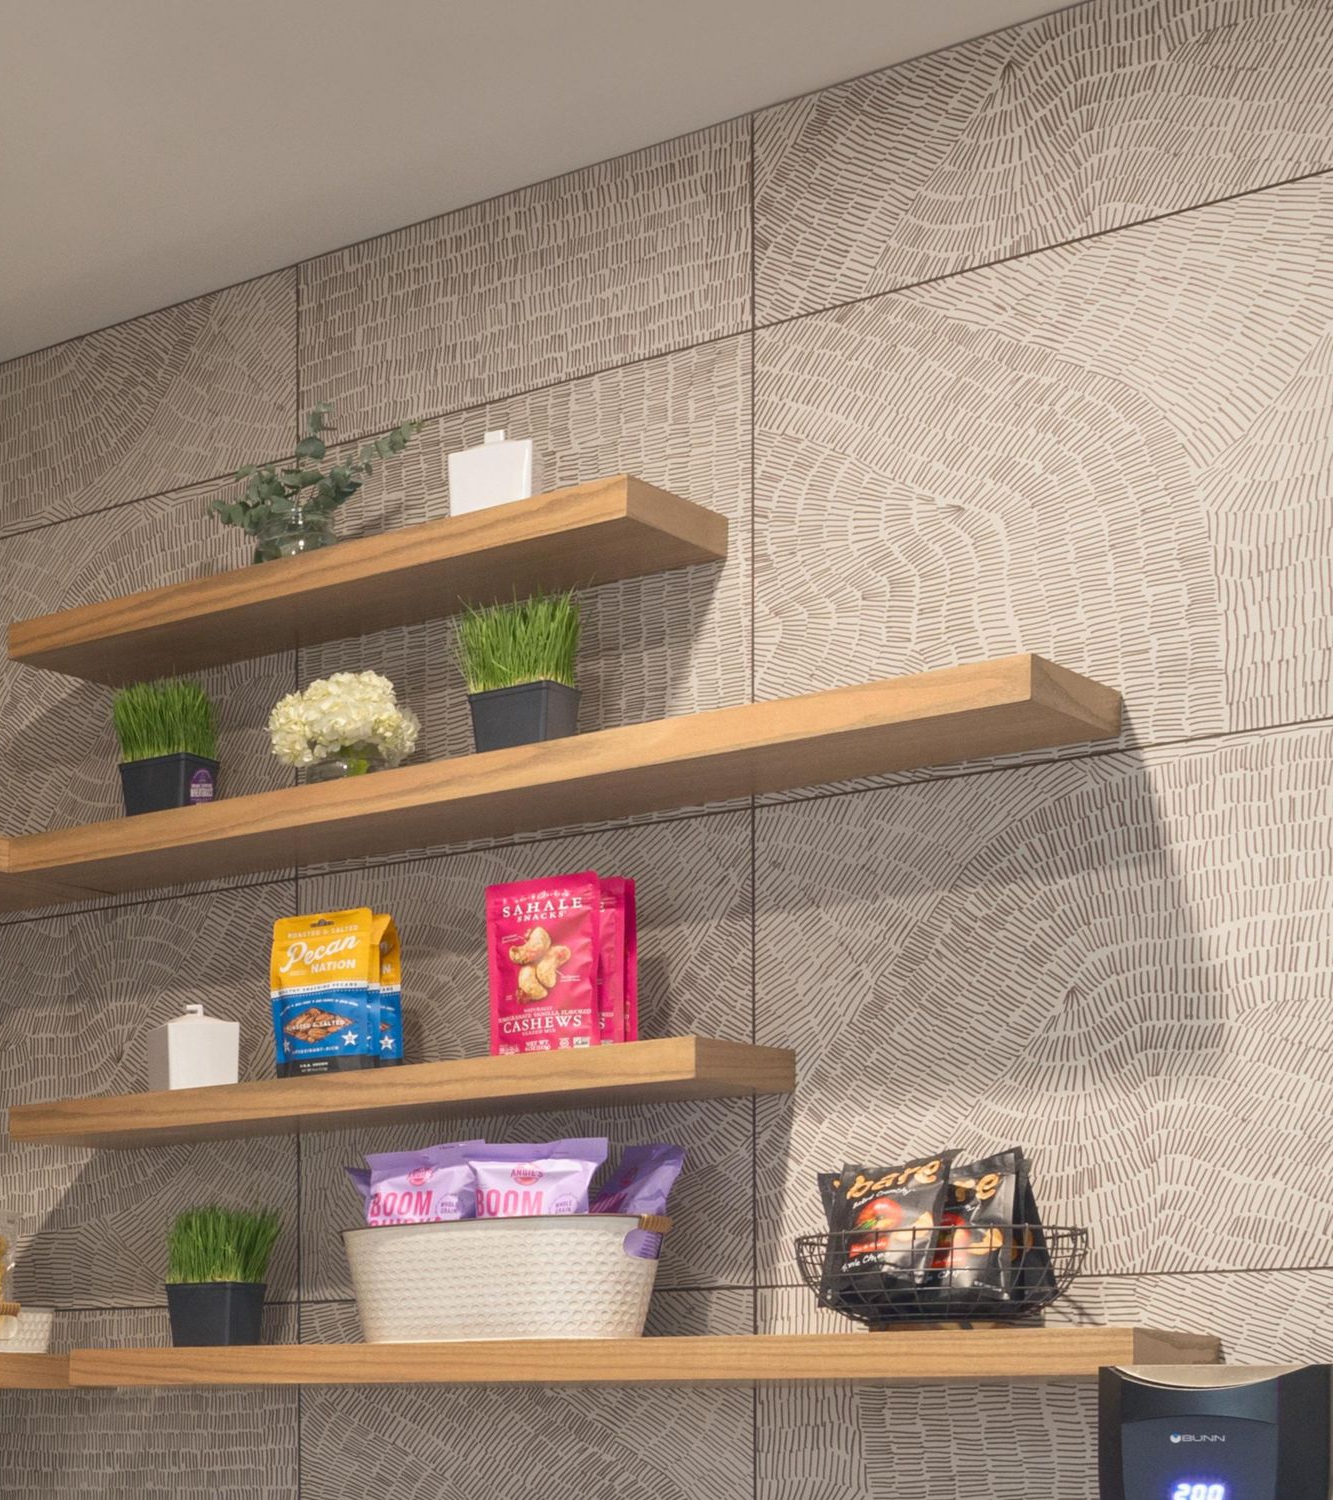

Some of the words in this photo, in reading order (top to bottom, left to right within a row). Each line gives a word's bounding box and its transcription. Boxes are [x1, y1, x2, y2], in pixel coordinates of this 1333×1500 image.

[502, 897, 583, 918] SAHALE
[517, 911, 565, 923] SNACKS
[279, 935, 360, 973] Pecan
[311, 959, 356, 974] NATION
[503, 1015, 582, 1034] CASHEWS
[511, 1168, 544, 1179] ANGIE'S
[847, 1159, 943, 1200] bare
[370, 1190, 433, 1217] BOOM
[476, 1189, 543, 1217] BOOM
[1182, 1433, 1226, 1442] BUNN
